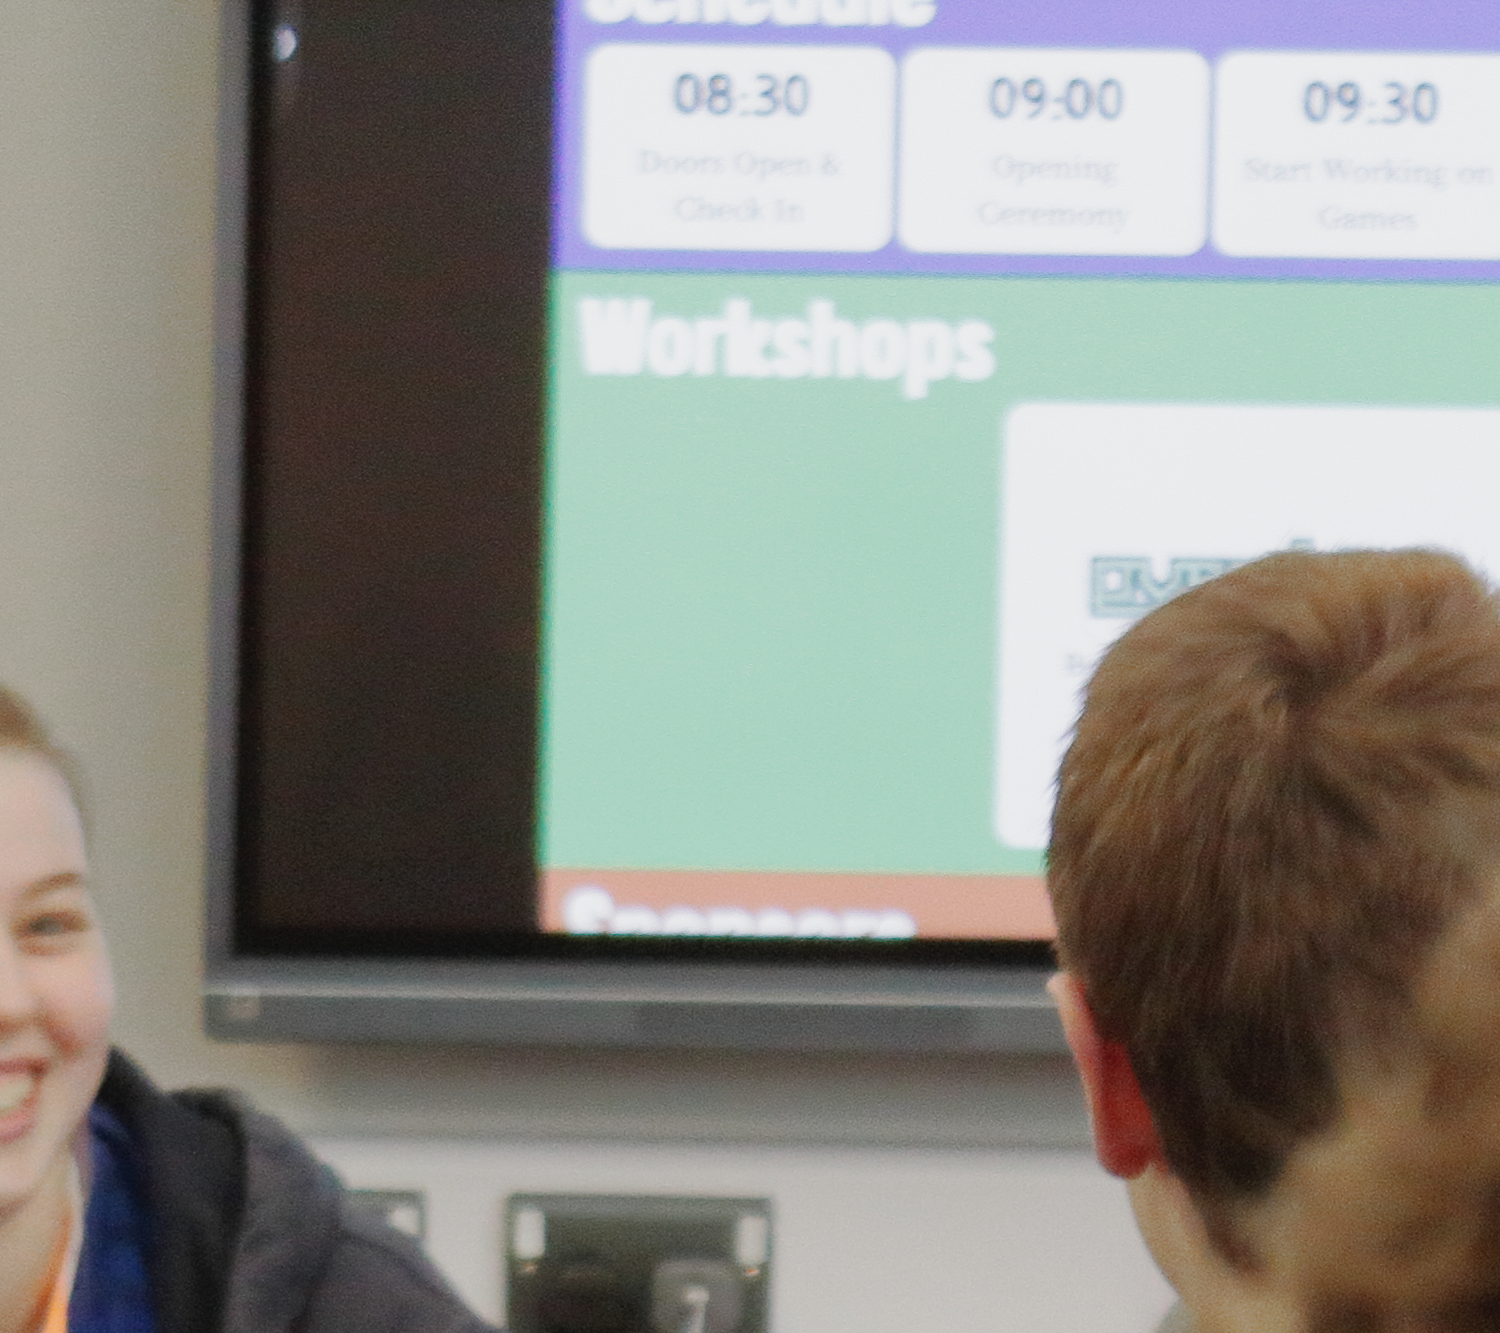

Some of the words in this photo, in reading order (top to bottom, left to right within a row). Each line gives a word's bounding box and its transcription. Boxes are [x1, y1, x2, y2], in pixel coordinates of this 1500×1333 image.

[672, 72, 811, 119] 08:30
[988, 76, 1125, 122] 09:00
[1302, 80, 1441, 127] 09:30
[636, 149, 727, 177] Doors
[732, 151, 813, 184] Open
[819, 153, 842, 179] &
[990, 152, 1120, 190] Opening
[1243, 157, 1314, 185] Start
[1321, 158, 1450, 193] Working
[1456, 166, 1495, 187] on
[673, 195, 766, 224] Check
[975, 200, 1130, 236] Ceremony
[1315, 204, 1420, 233] Games
[576, 296, 996, 399] Workshops
